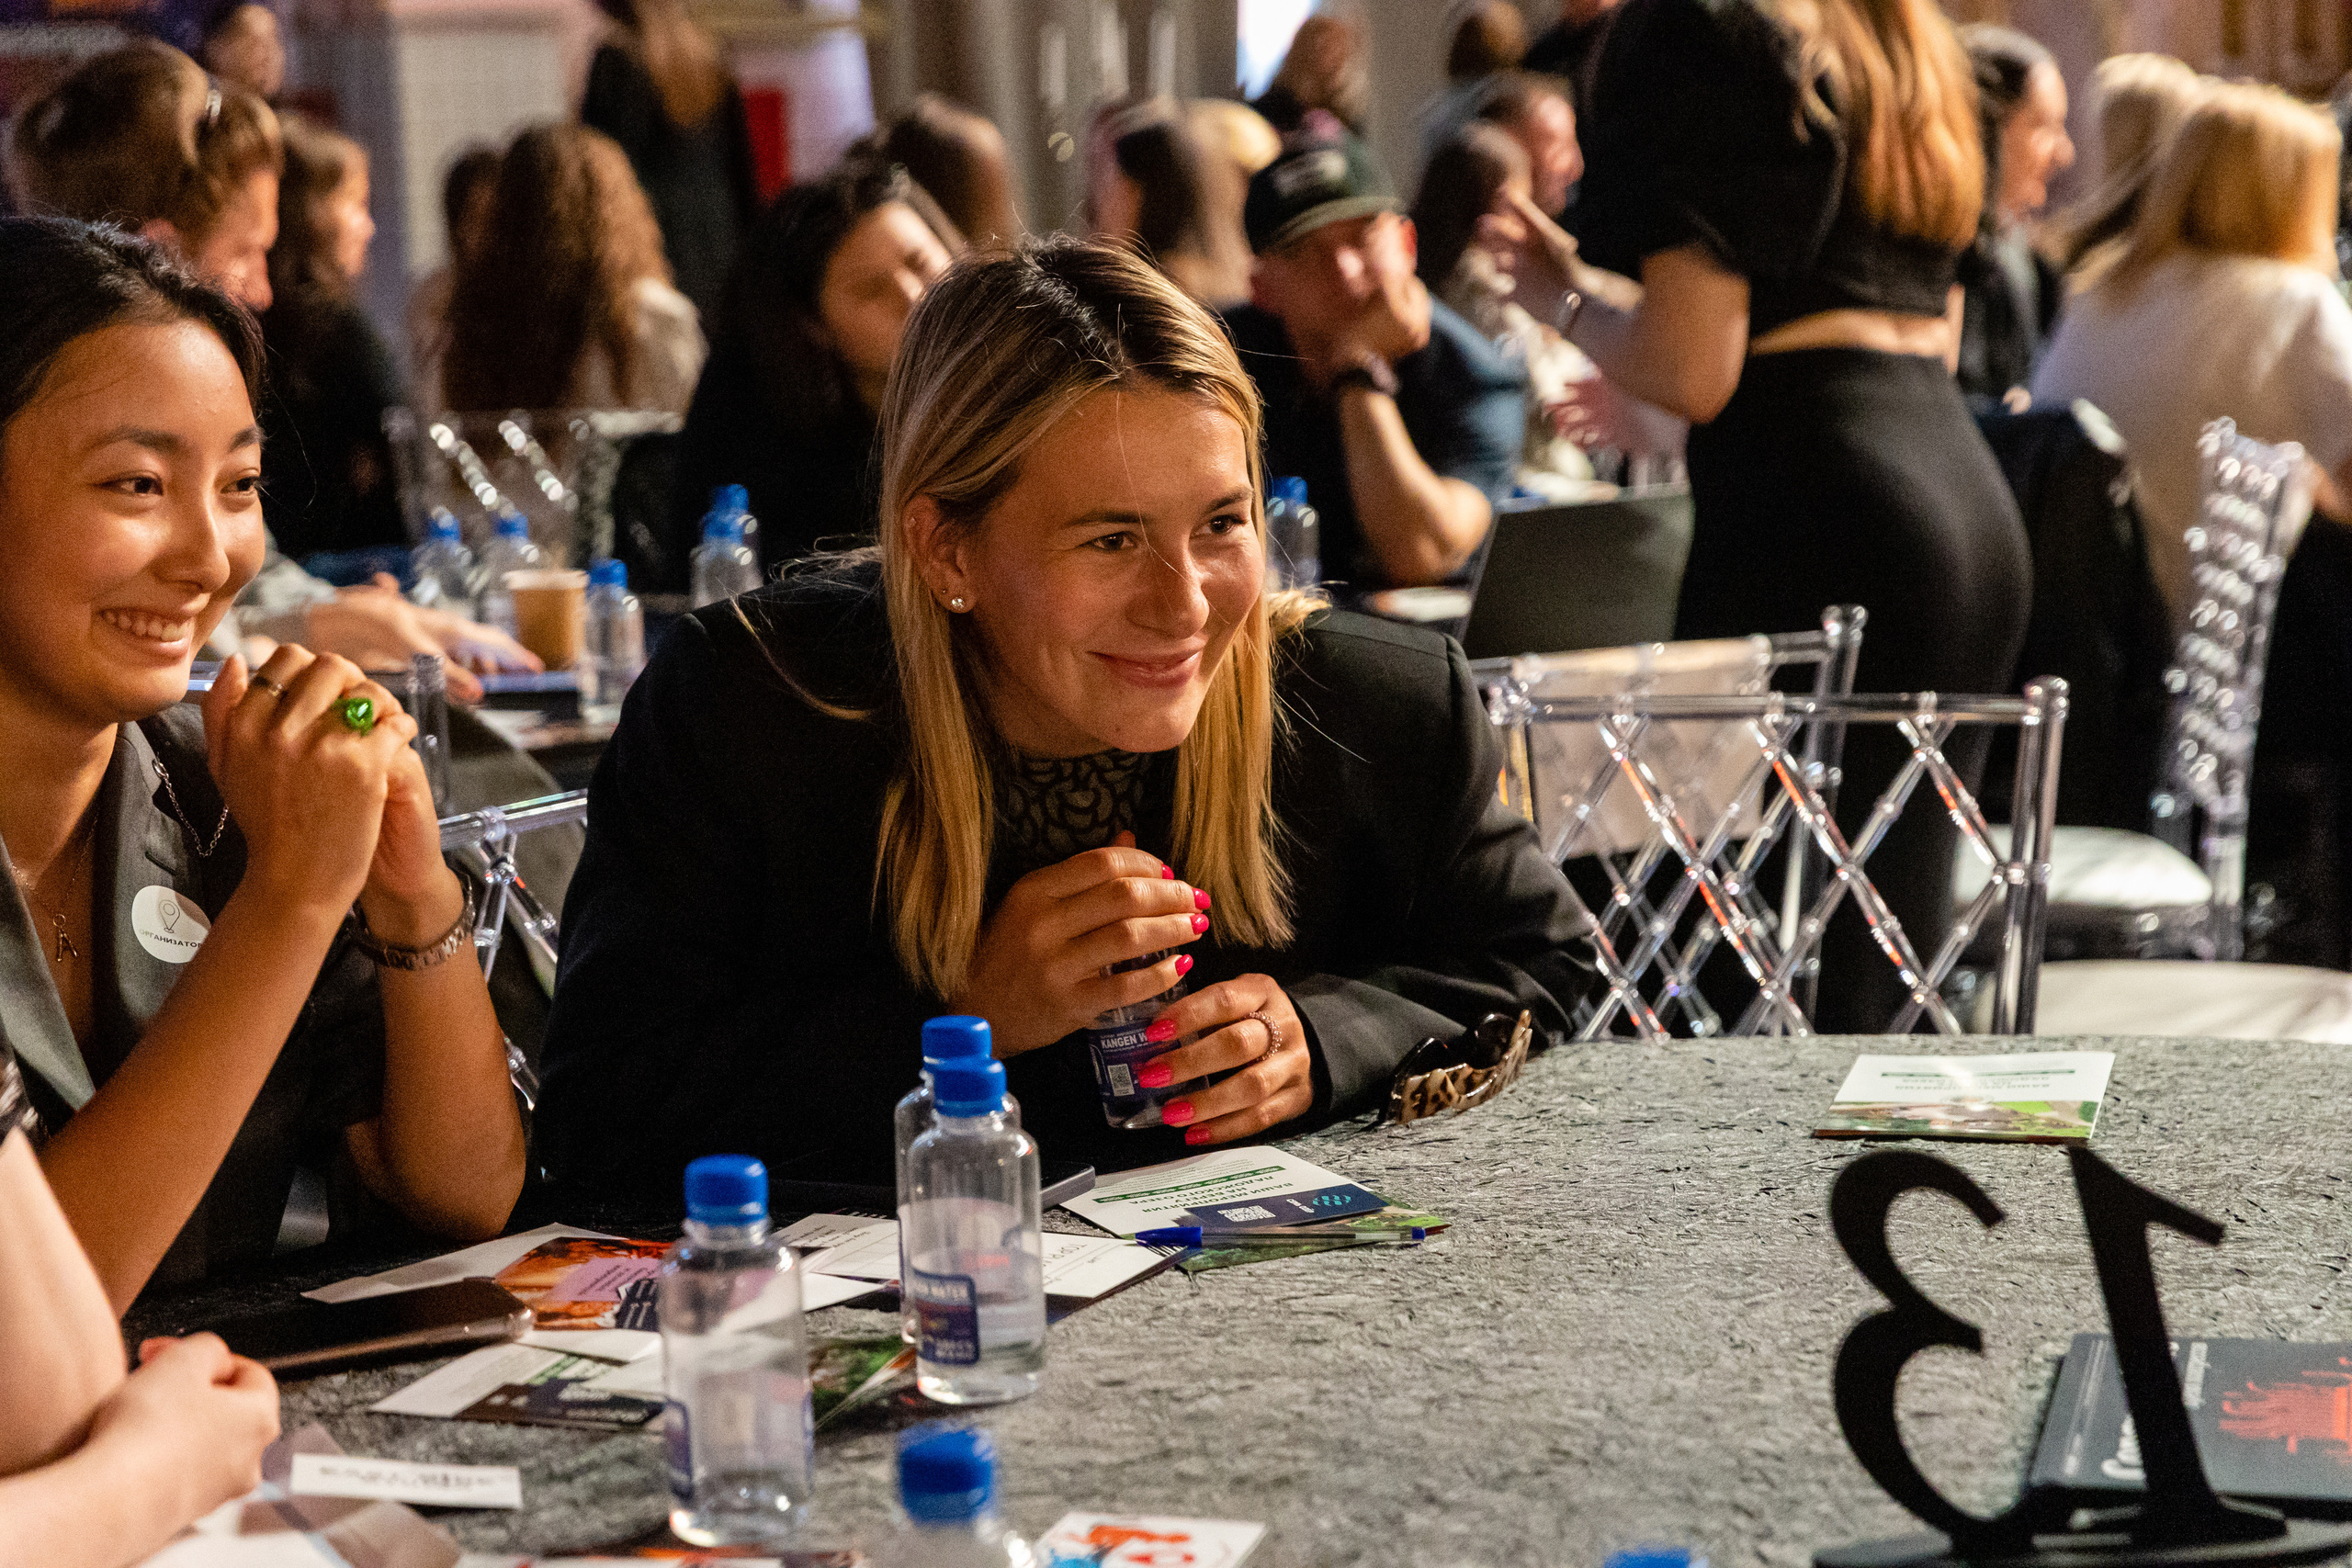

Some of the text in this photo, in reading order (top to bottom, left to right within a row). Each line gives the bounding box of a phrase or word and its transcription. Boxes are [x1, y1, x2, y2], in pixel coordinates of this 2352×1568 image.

[1101, 1034, 1137, 1048] KANGEN
[1142, 1182, 1294, 1213] ВАШИ МЕРОПРИЯТИЯ
[1177, 1176, 1273, 1198] ЛАДОЖСКОГО
